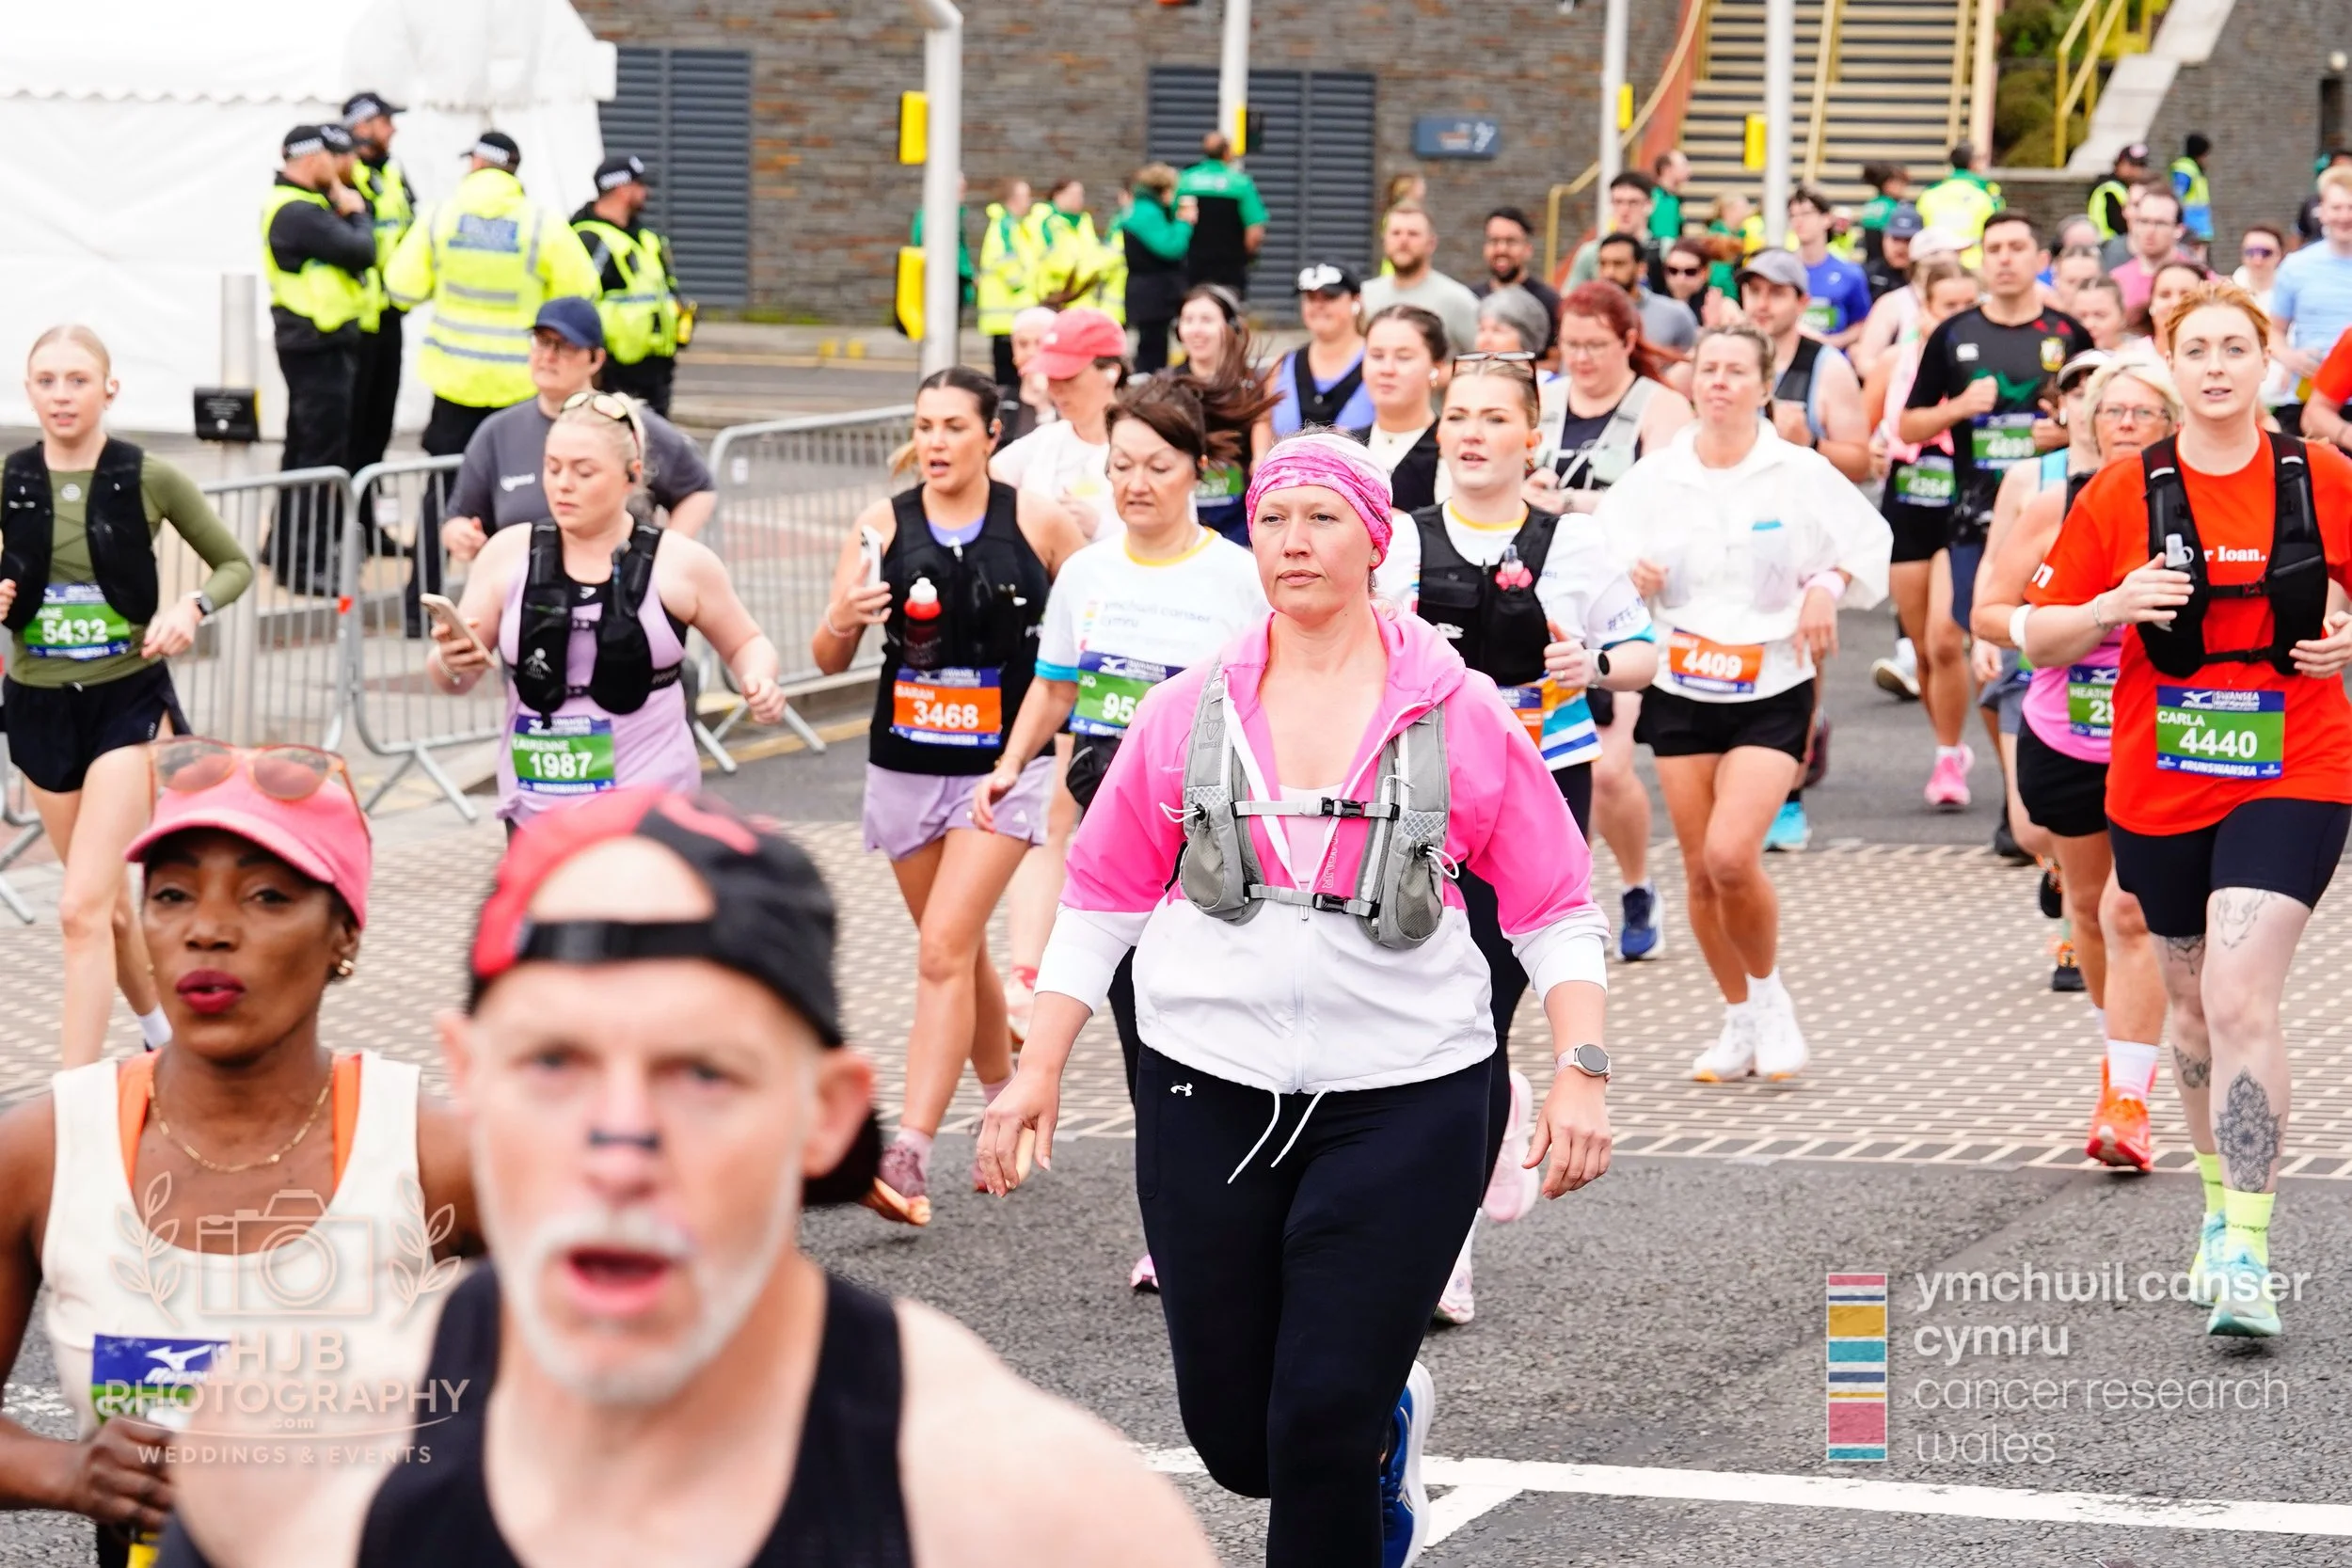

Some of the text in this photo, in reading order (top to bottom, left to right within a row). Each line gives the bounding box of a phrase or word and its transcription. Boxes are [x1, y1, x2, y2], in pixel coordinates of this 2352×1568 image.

[2217, 546, 2266, 562] loan.
[42, 618, 109, 645] 5432
[1681, 649, 1742, 680] 4409
[913, 700, 979, 730] 3468
[1102, 692, 1136, 724] 95
[2156, 710, 2206, 727] CARLA
[2179, 727, 2258, 759] 4440
[529, 752, 594, 779] 1987
[2179, 759, 2258, 777] #RUNSWANSEA
